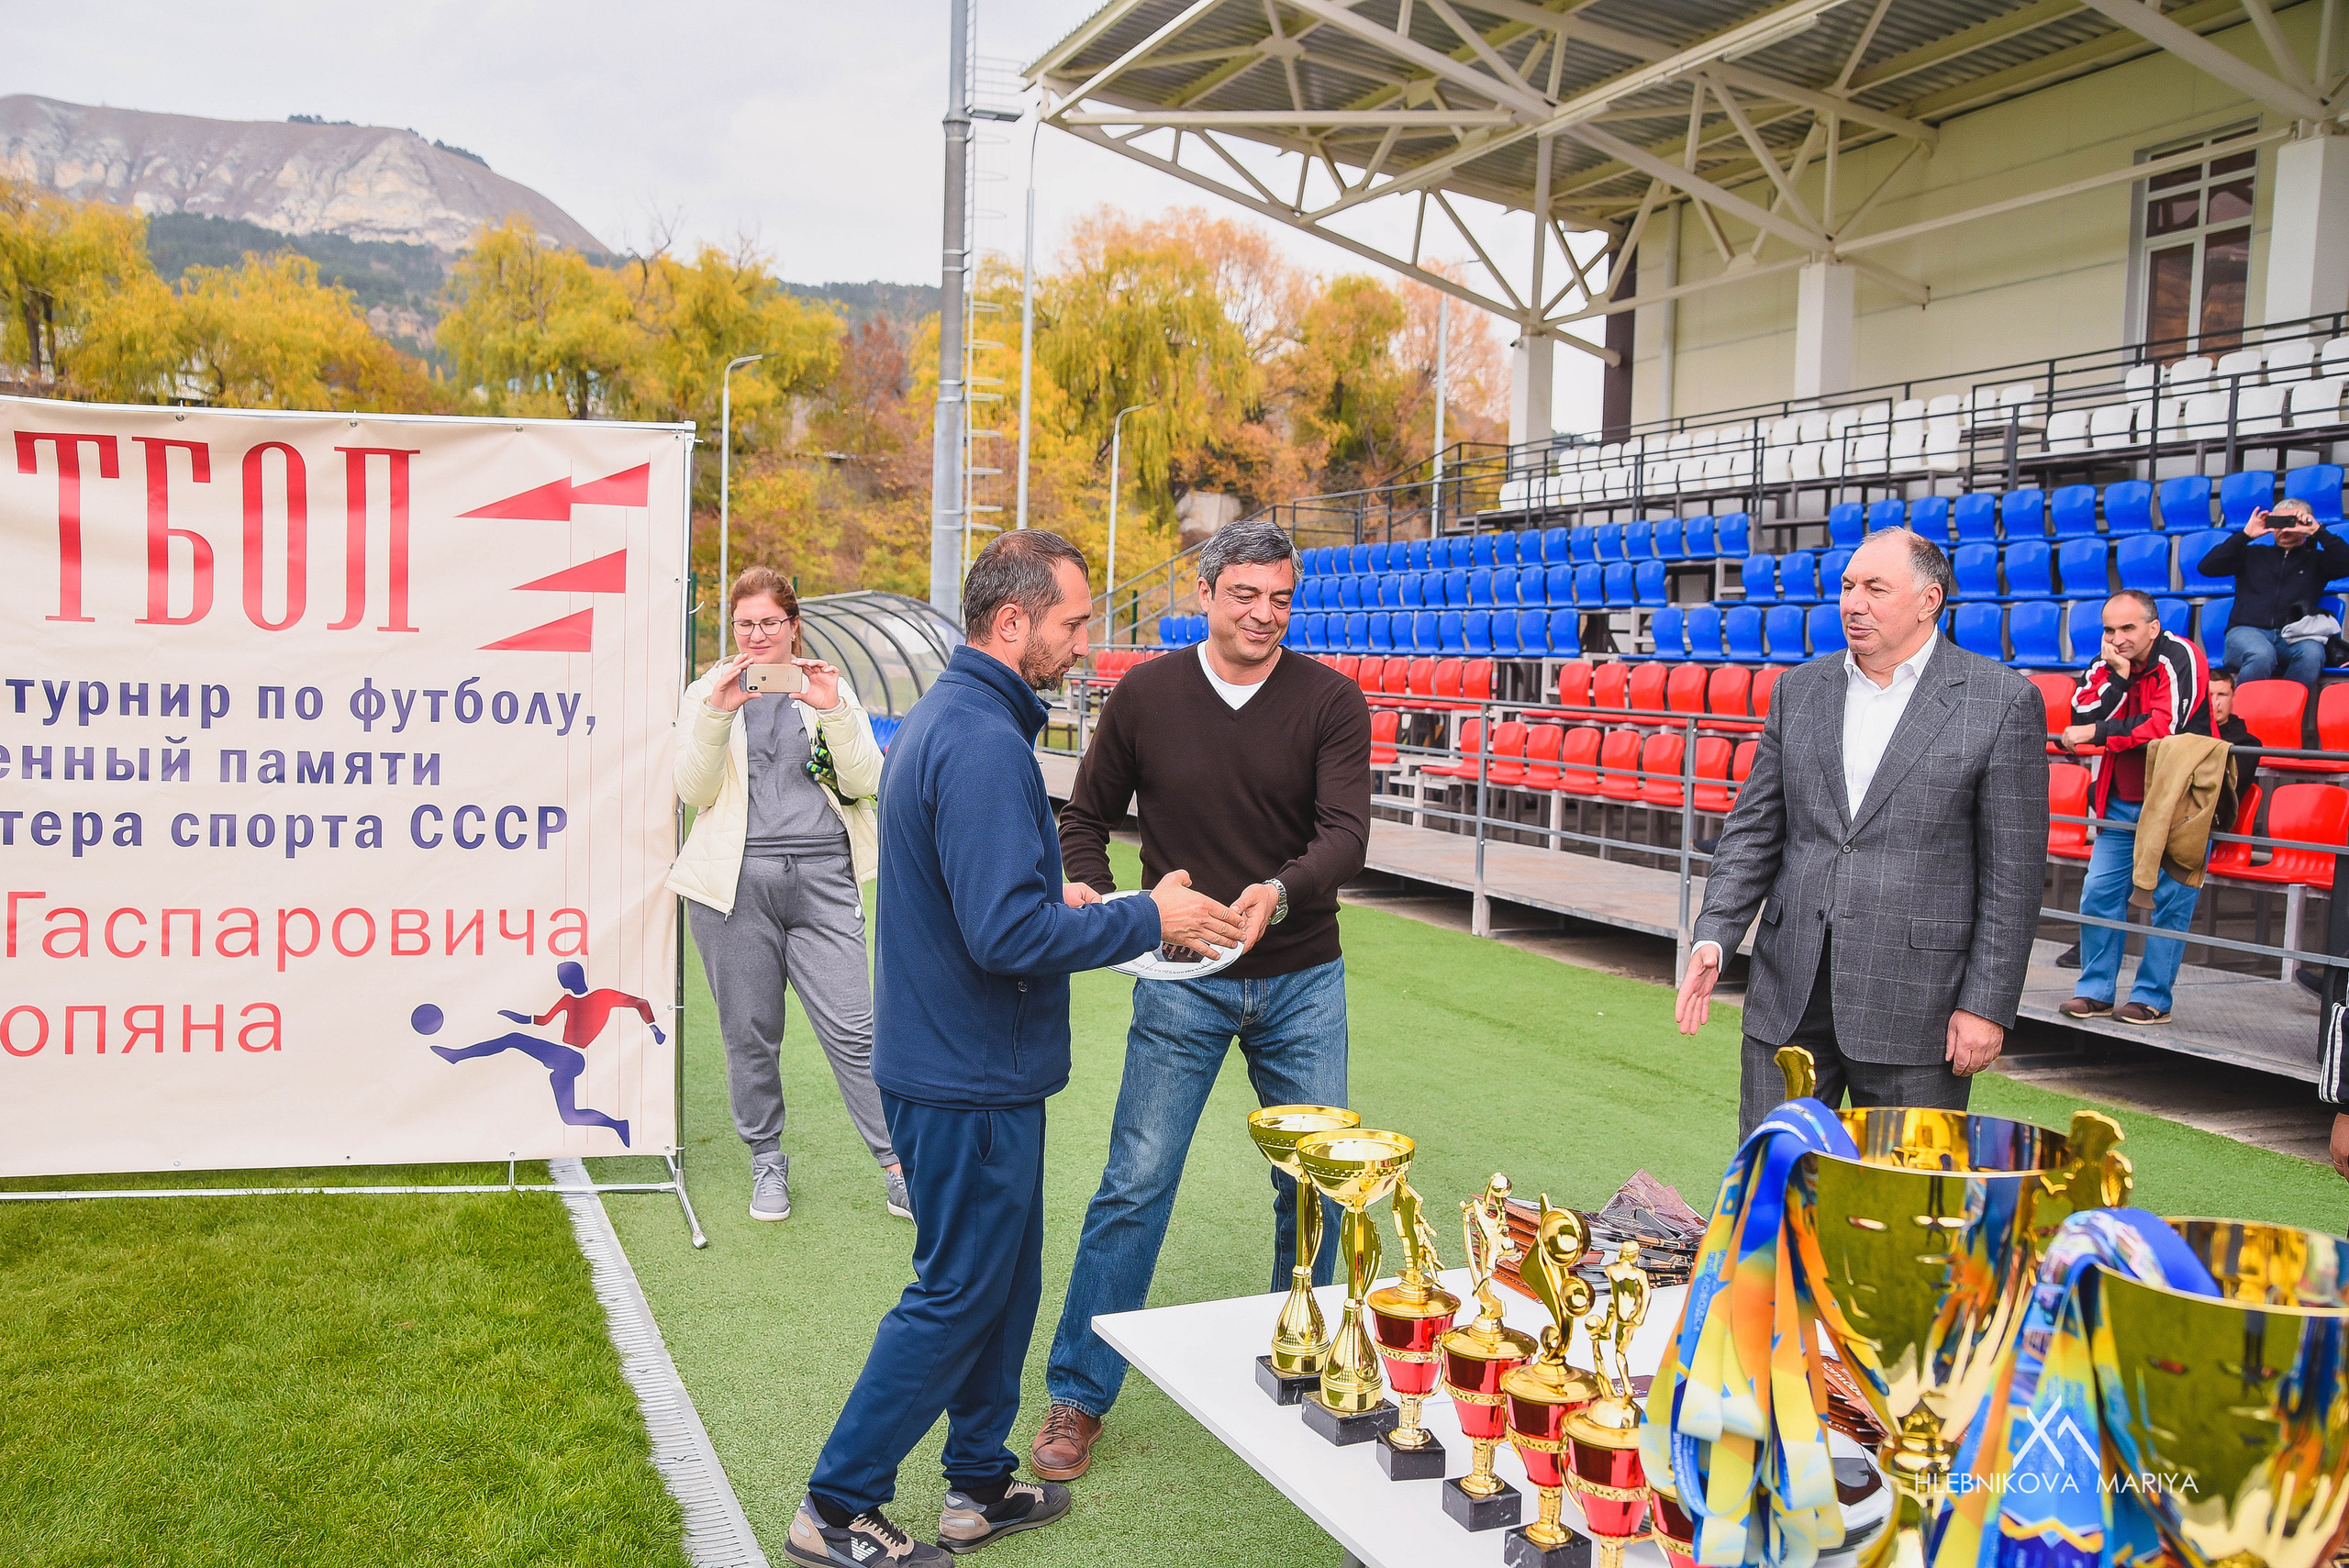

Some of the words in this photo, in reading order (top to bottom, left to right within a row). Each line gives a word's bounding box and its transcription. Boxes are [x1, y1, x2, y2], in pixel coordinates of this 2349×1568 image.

[13, 429, 421, 633] ТБОЛ
[5, 677, 230, 728] турнир
[258, 684, 324, 721] по
[349, 676, 596, 737] футболу,
[219, 749, 440, 785] памяти
[0, 810, 143, 858] тера
[171, 811, 383, 859] спорта
[410, 804, 568, 851] СССР
[6, 891, 589, 973] Гаспаровича
[0, 1003, 283, 1058] опяна
